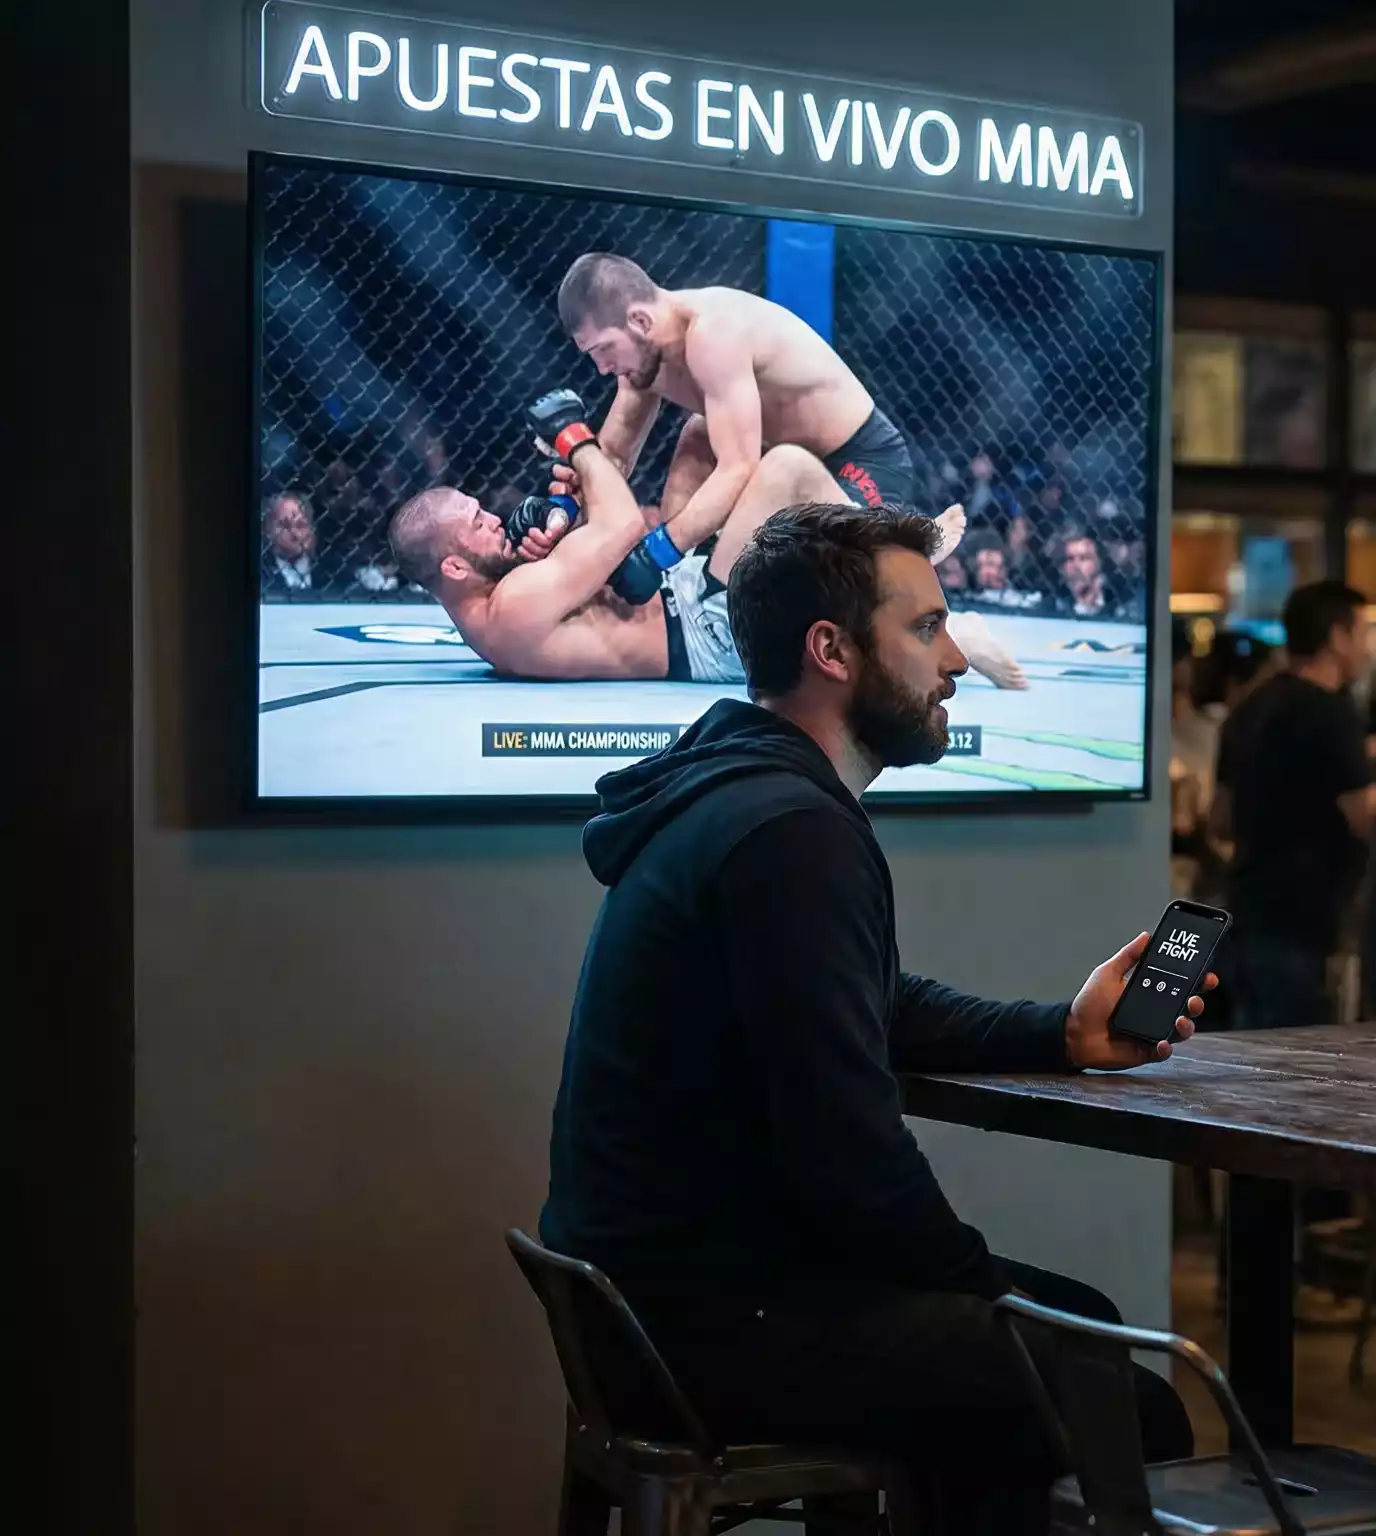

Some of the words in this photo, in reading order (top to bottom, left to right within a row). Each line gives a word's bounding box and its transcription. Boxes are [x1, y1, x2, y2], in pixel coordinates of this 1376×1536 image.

[284, 24, 674, 144] APUESTAS
[697, 78, 785, 156] EN
[802, 92, 961, 177] VIVO
[978, 117, 1135, 200] MMA
[493, 731, 528, 749] LIVE:
[530, 731, 566, 749] MMA
[568, 731, 672, 750] CHAMPIONSHIP
[1168, 928, 1200, 948] LIVE
